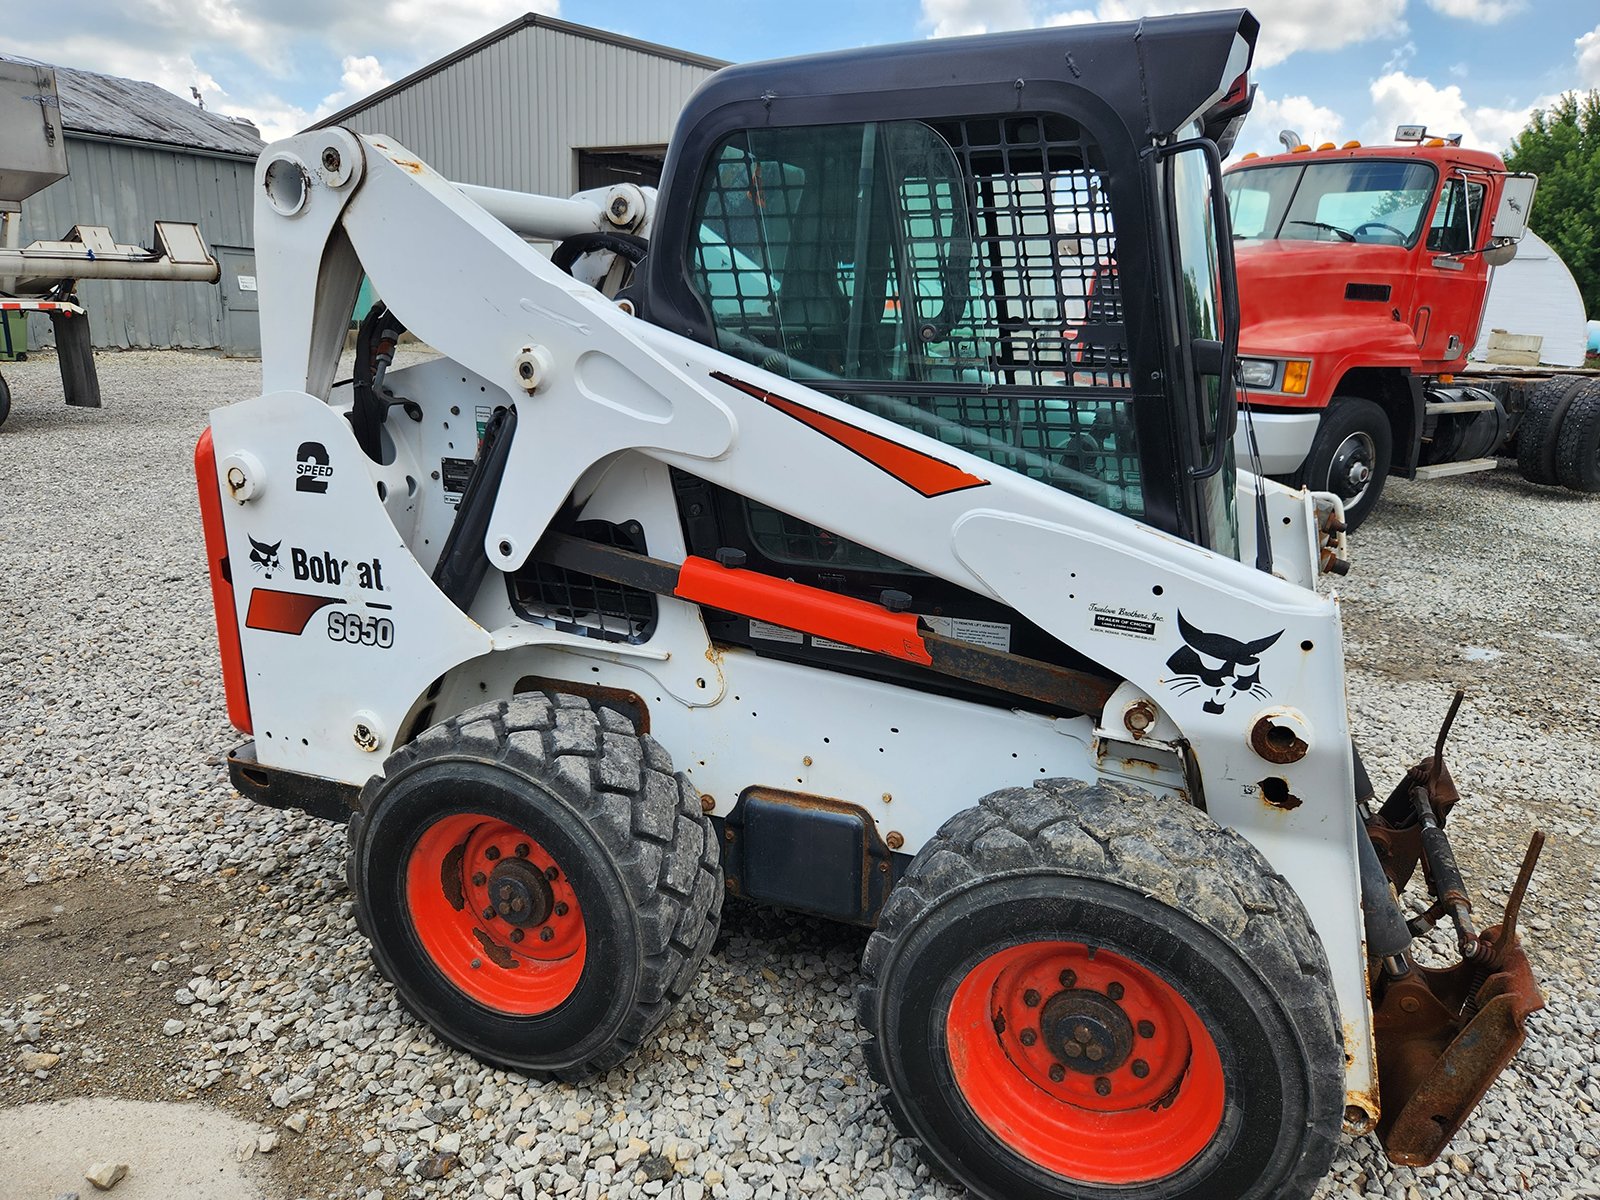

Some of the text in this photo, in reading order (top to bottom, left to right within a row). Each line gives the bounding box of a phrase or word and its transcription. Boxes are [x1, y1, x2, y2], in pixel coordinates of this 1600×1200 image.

[295, 441, 330, 494] 2
[296, 464, 334, 477] SPEED
[291, 547, 384, 591] Bobat
[328, 611, 395, 649] S650
